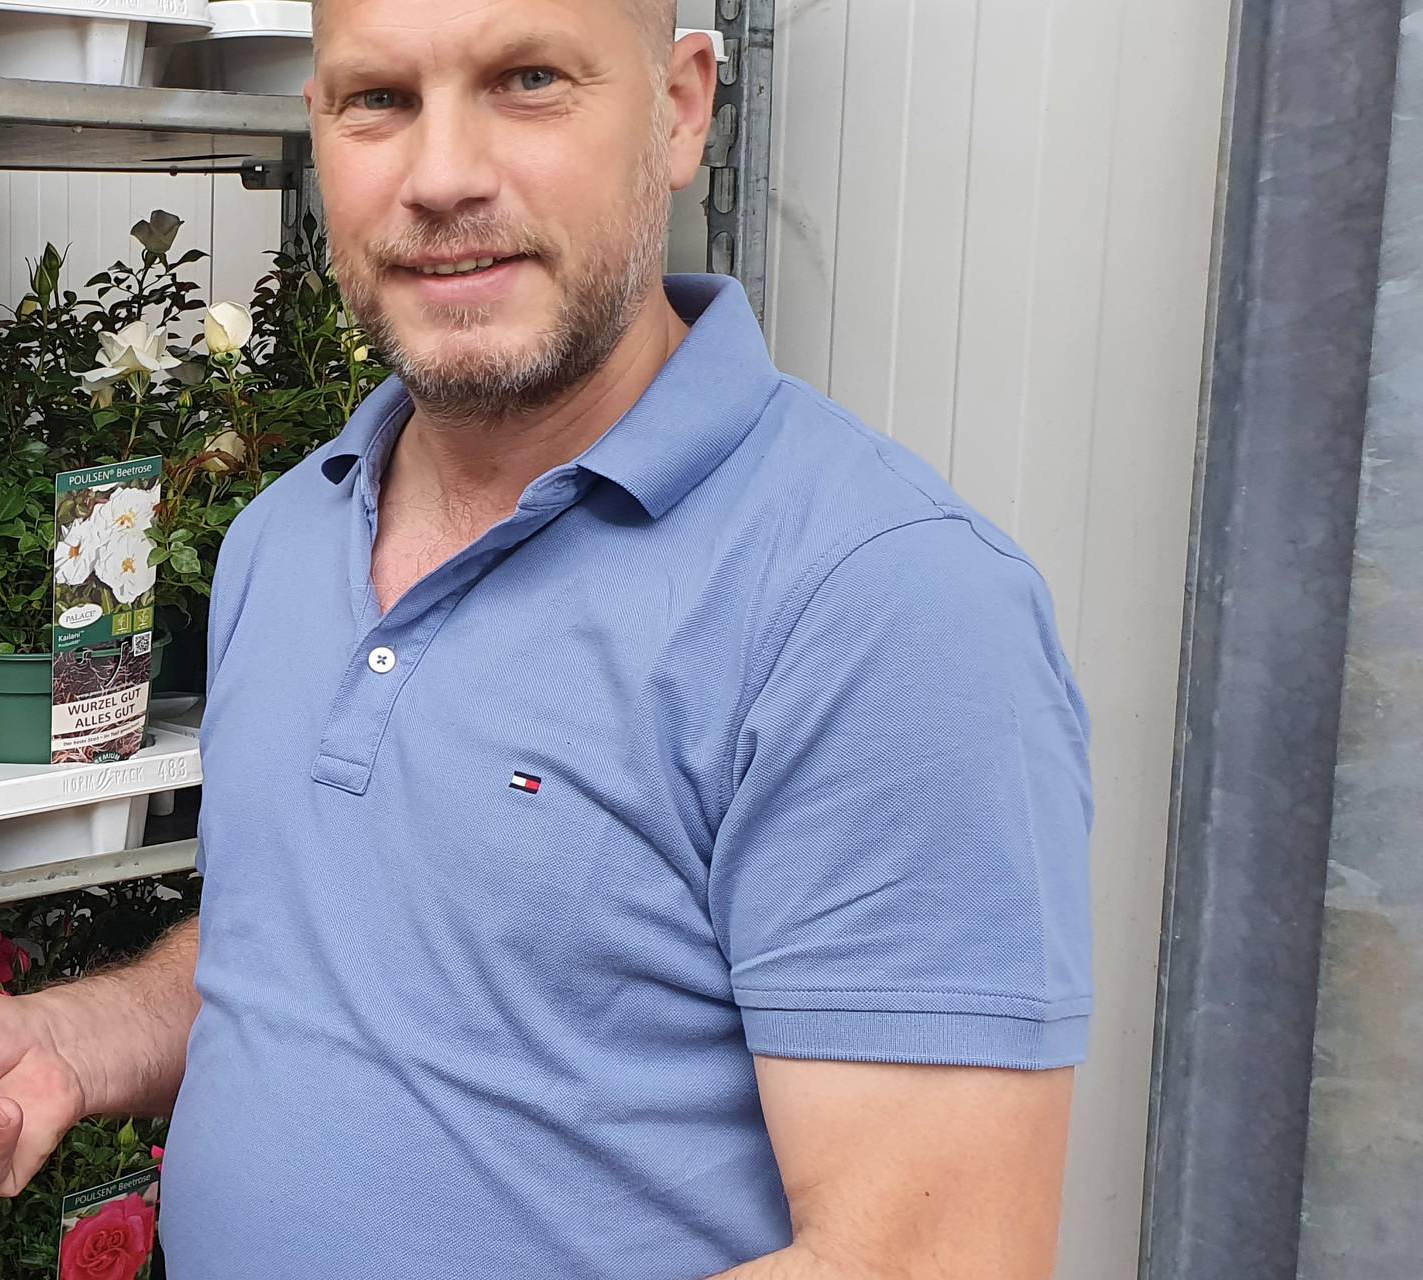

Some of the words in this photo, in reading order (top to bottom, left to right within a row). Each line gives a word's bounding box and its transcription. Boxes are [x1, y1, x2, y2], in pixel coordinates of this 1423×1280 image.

[116, 464, 152, 478] Beetrose
[67, 697, 117, 715] WURZEL
[120, 687, 142, 703] GUT
[75, 713, 111, 729] ALLES
[114, 704, 136, 719] GUT
[115, 766, 144, 784] PACK
[157, 757, 187, 781] 483
[118, 1174, 151, 1191] Beetrose
